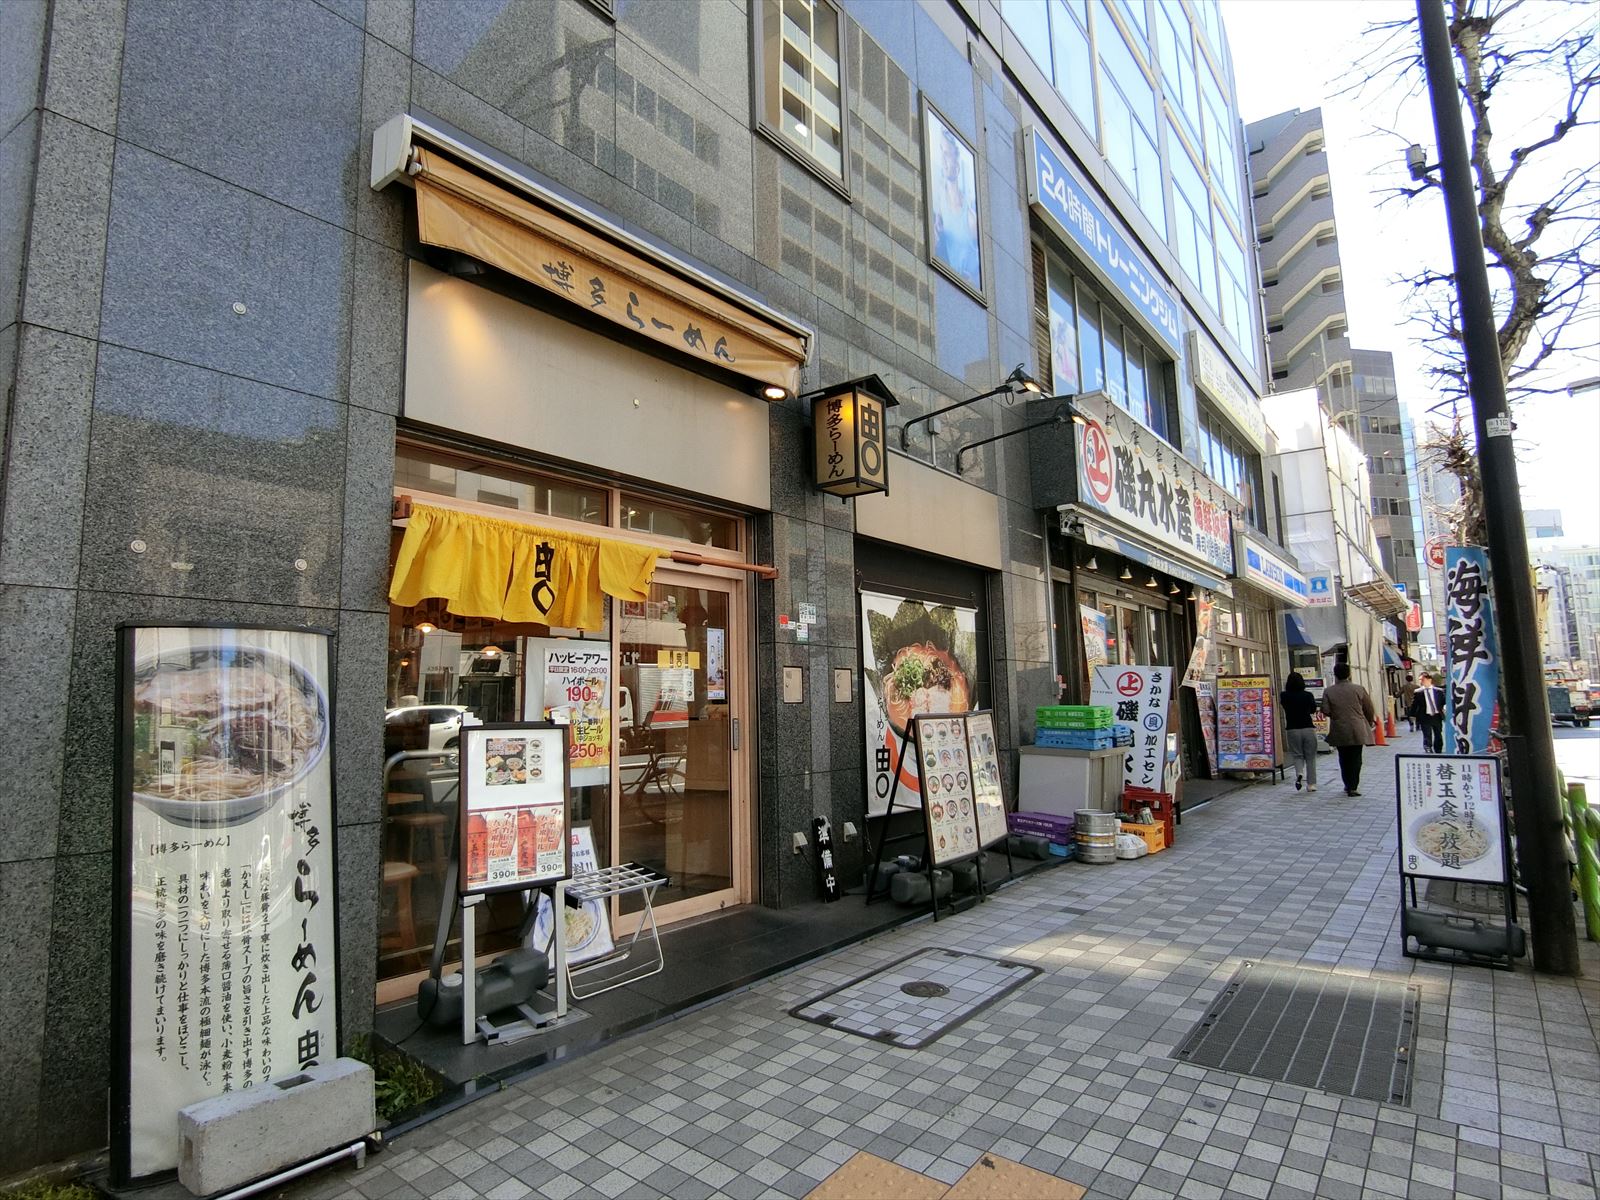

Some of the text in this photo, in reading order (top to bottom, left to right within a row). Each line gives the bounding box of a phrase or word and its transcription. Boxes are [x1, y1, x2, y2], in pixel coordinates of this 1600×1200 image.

[1040, 153, 1178, 341] 24時間トレーニングジム
[541, 260, 736, 364] 博多らーめん
[826, 398, 845, 479] 博多らーめん
[1113, 445, 1194, 545] 磯丸水産
[548, 651, 608, 665] ハッピーアワー
[562, 676, 598, 686] ハイボール
[566, 686, 598, 702] 190円
[569, 742, 603, 760] 250円
[576, 725, 604, 735] 生ビール
[1435, 763, 1463, 870] 替玉食べ放題
[492, 870, 515, 880] 390円
[288, 801, 325, 1020] 博多らーめん
